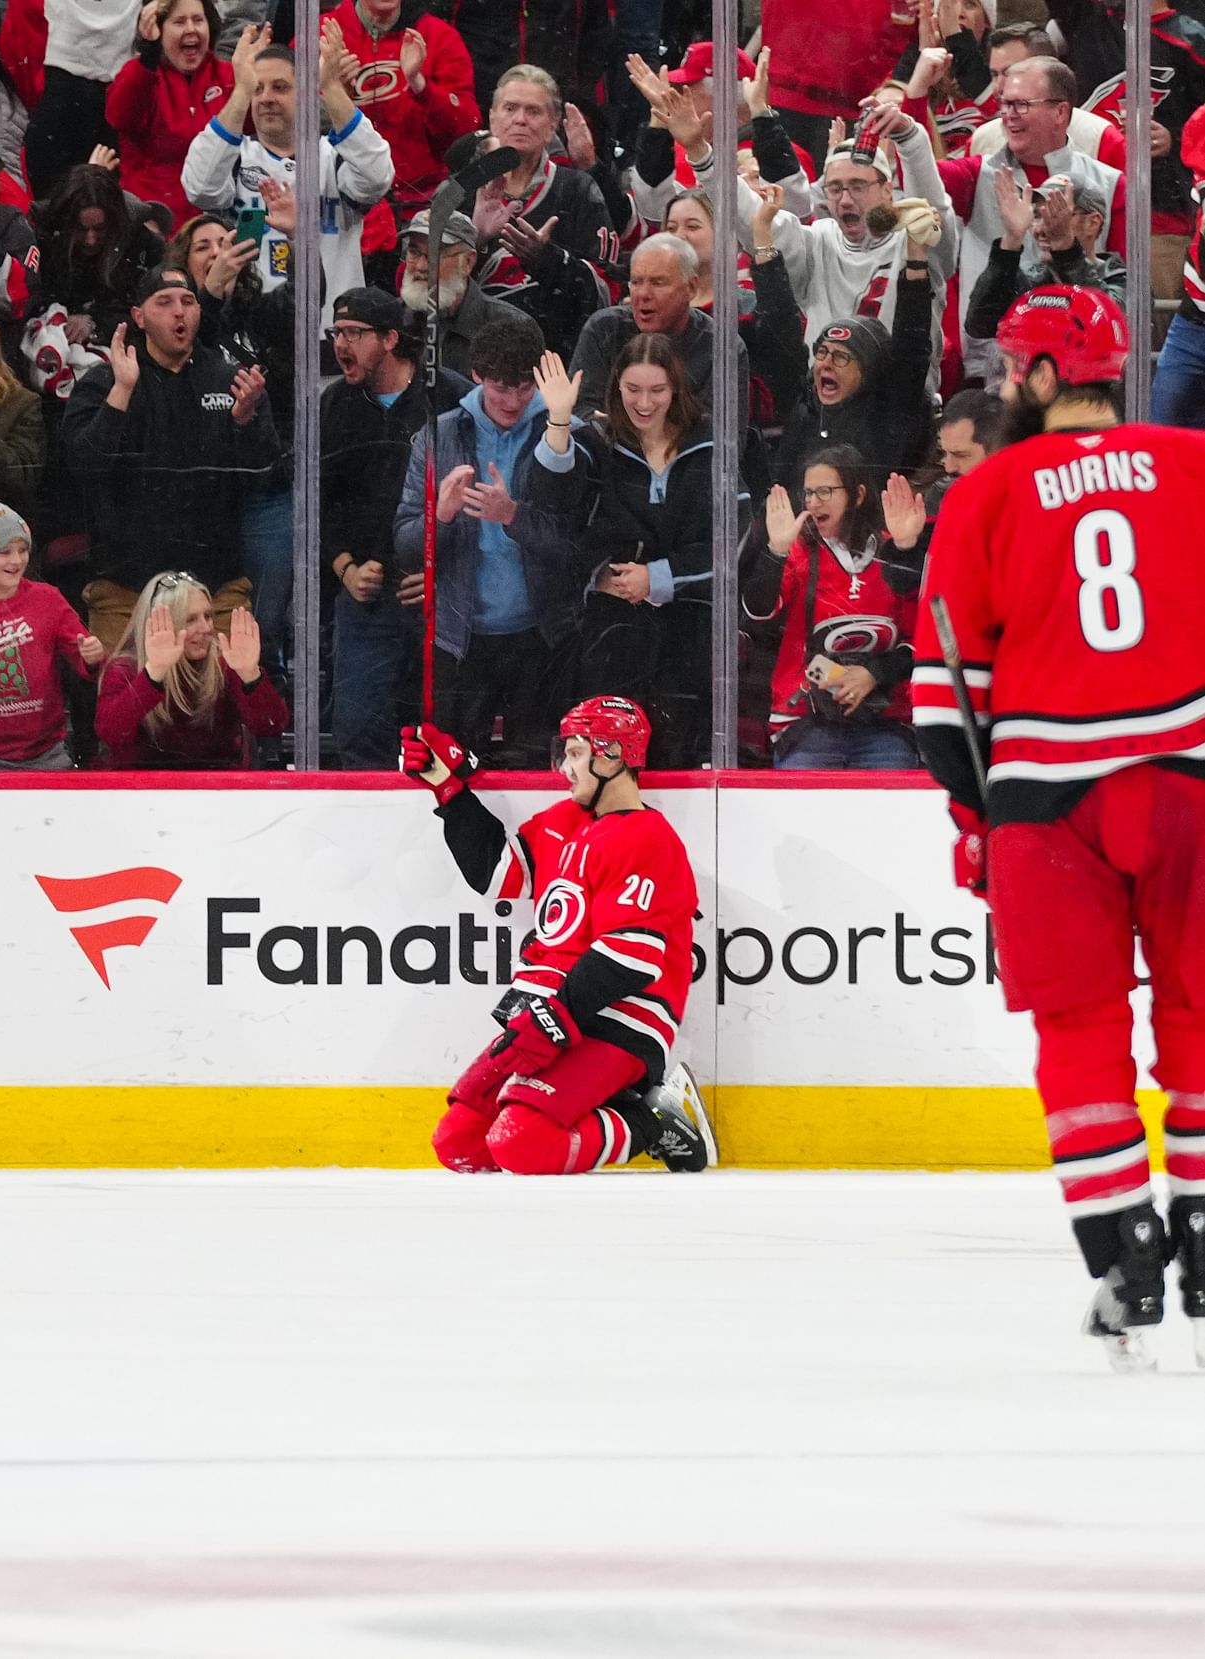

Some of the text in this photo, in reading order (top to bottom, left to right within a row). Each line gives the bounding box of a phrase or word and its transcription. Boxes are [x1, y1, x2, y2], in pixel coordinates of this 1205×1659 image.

[597, 226, 620, 263] 11
[1027, 295, 1069, 309] Lenovo
[1033, 450, 1158, 510] BURNS
[1073, 508, 1146, 653] 8
[602, 700, 633, 710] Lenovo
[616, 873, 656, 912] 20
[207, 896, 531, 986] Fanati
[691, 908, 995, 1006] ports
